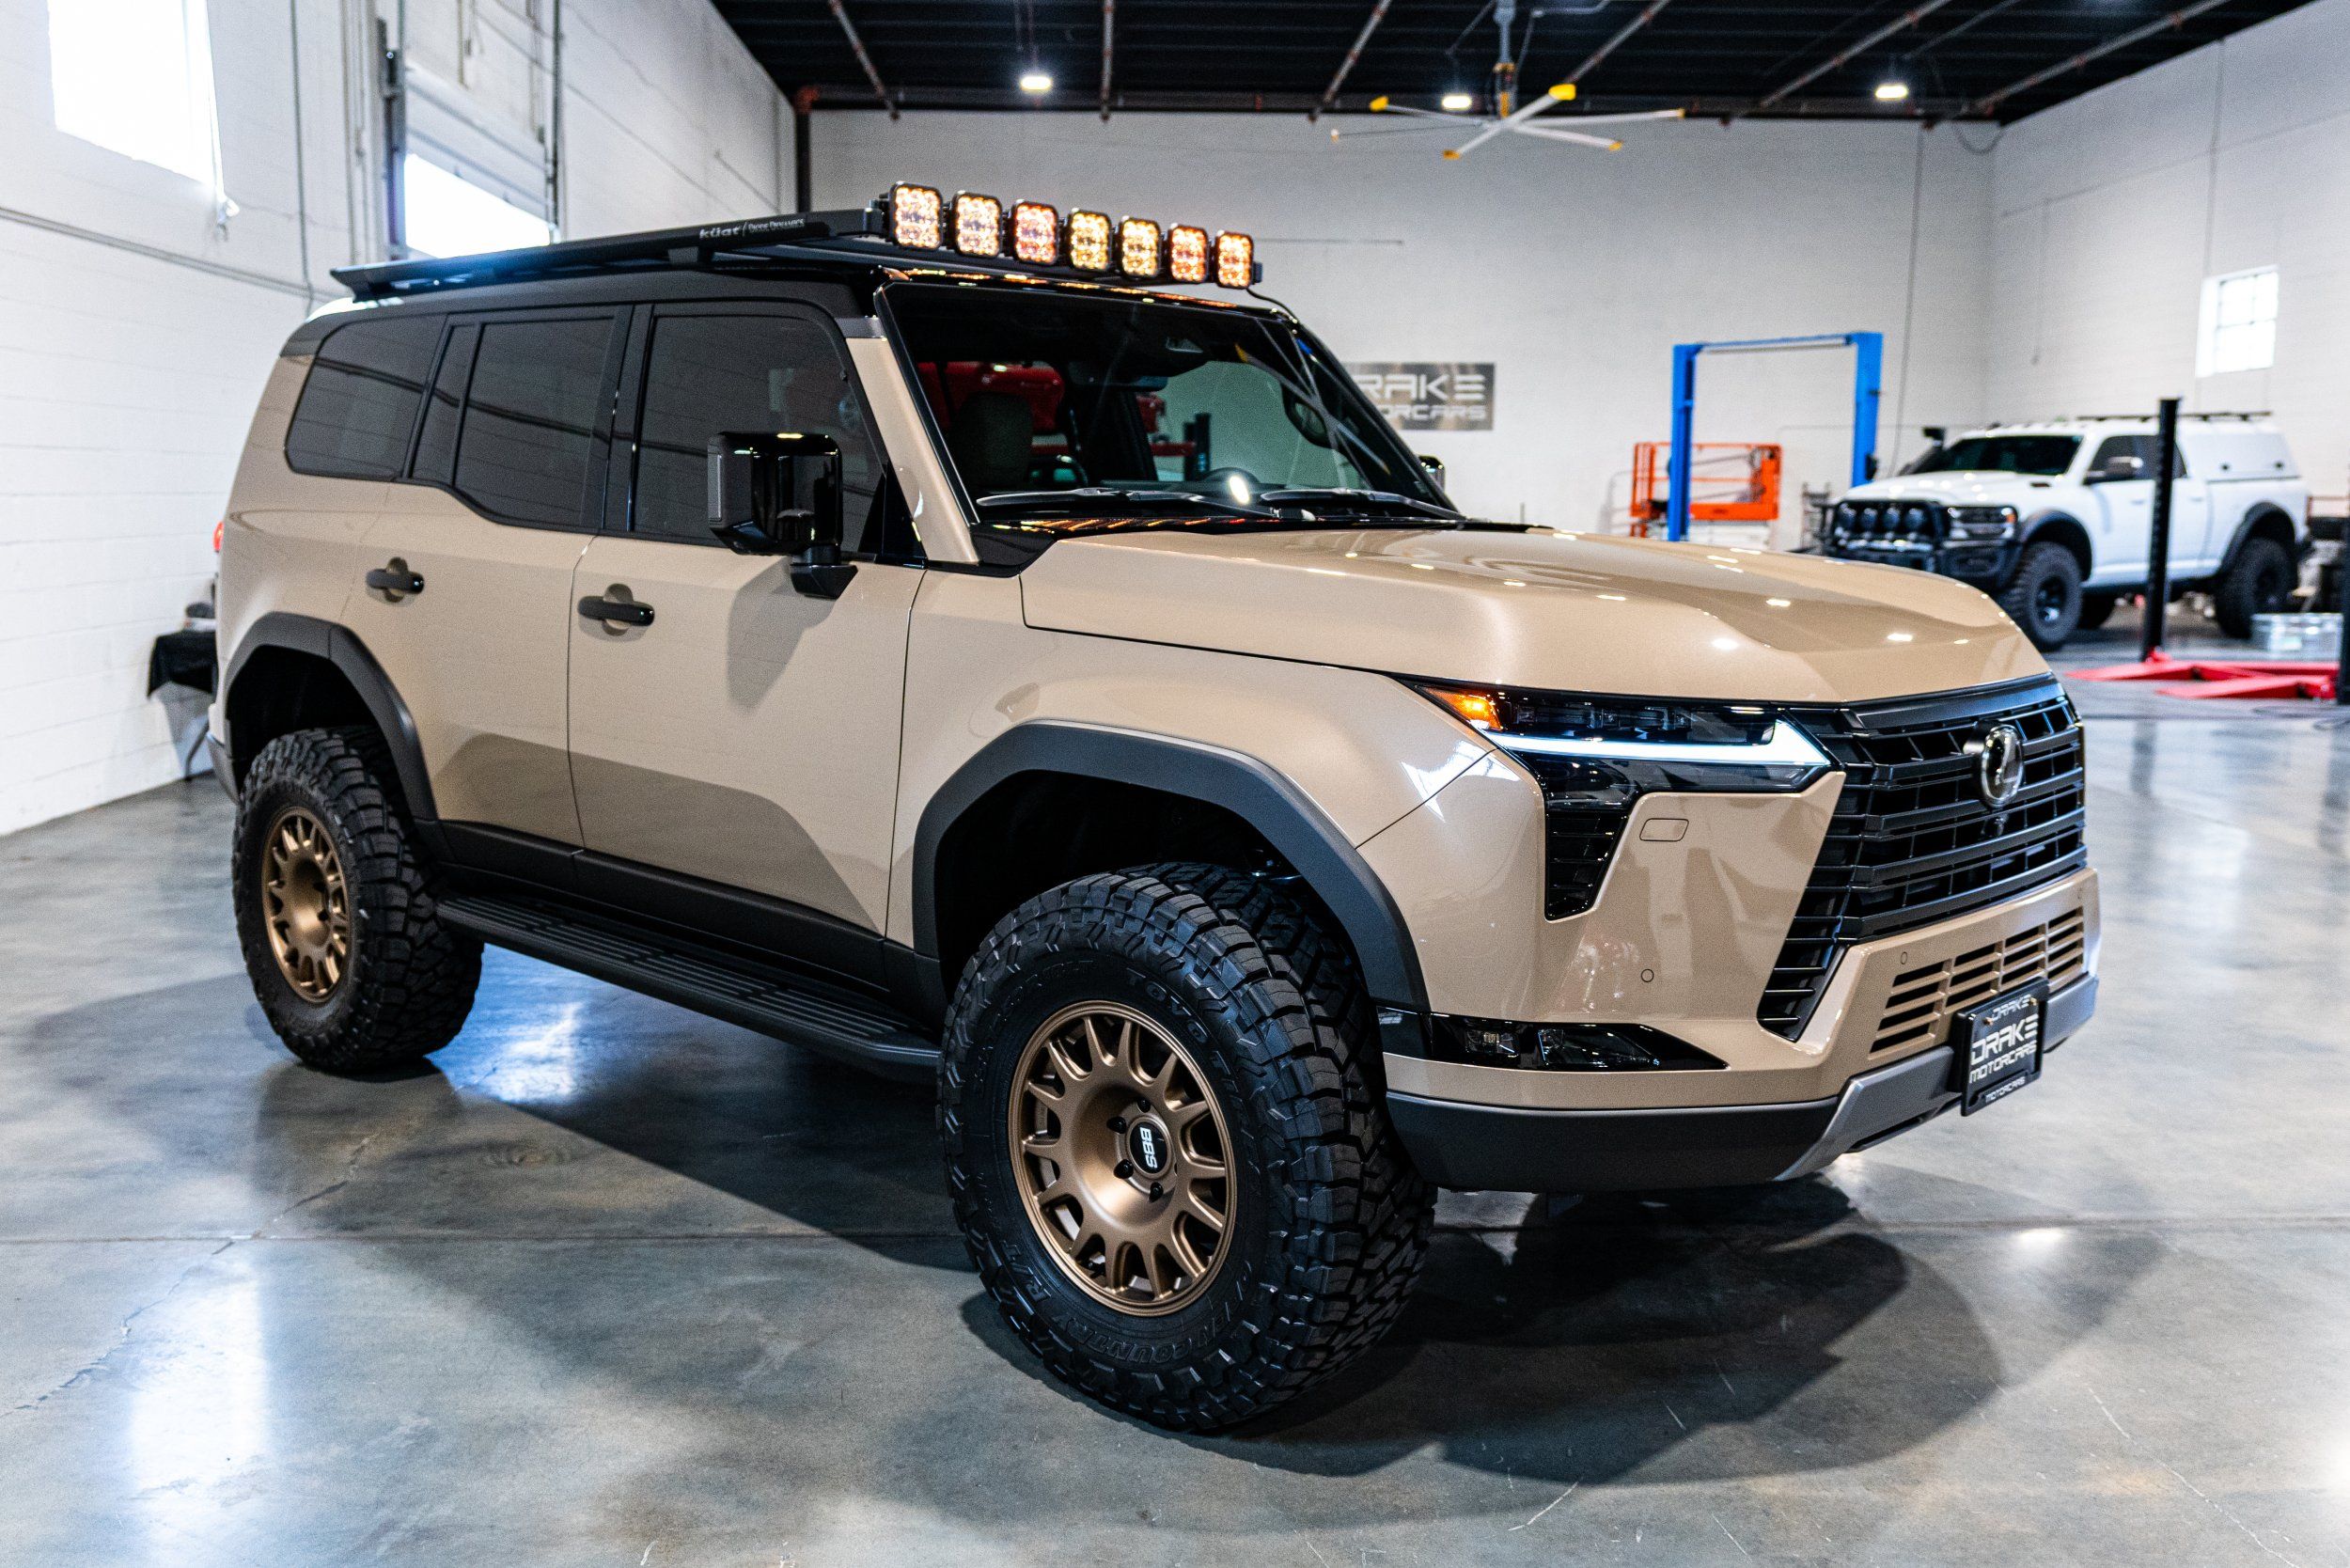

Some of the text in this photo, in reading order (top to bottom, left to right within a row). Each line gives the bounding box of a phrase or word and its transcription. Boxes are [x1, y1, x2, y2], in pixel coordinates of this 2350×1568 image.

[1352, 373, 1485, 400] RAKE
[1376, 404, 1487, 420] ORCARS
[1125, 966, 1210, 1045] TOYO
[1993, 994, 2030, 1021] DRAKE
[1970, 1013, 2039, 1066] DRAKE
[1968, 1040, 2037, 1084] MOTORCARS
[1985, 1076, 2027, 1105] MOTORCARS
[1139, 1126, 1158, 1169] BBS
[1051, 1310, 1194, 1365] COUNTRY
